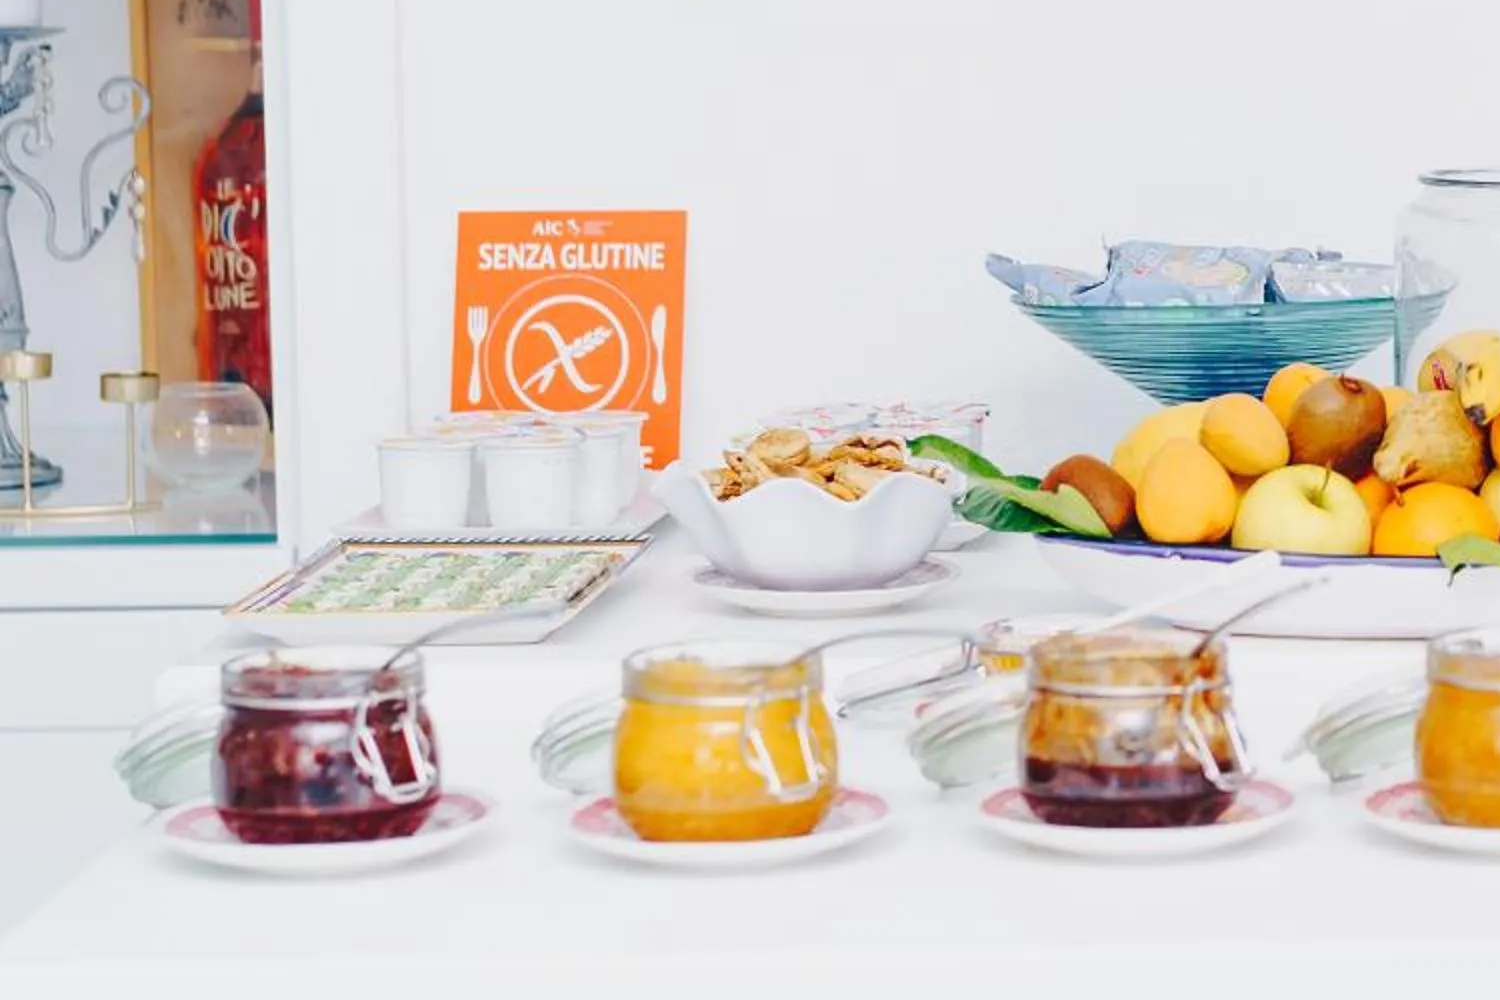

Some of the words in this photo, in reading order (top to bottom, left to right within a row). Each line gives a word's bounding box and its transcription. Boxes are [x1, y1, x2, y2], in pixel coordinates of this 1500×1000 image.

[532, 219, 564, 236] AIC
[478, 242, 556, 271] SENZA
[560, 241, 665, 270] GLUTINE
[205, 282, 260, 311] LUNE
